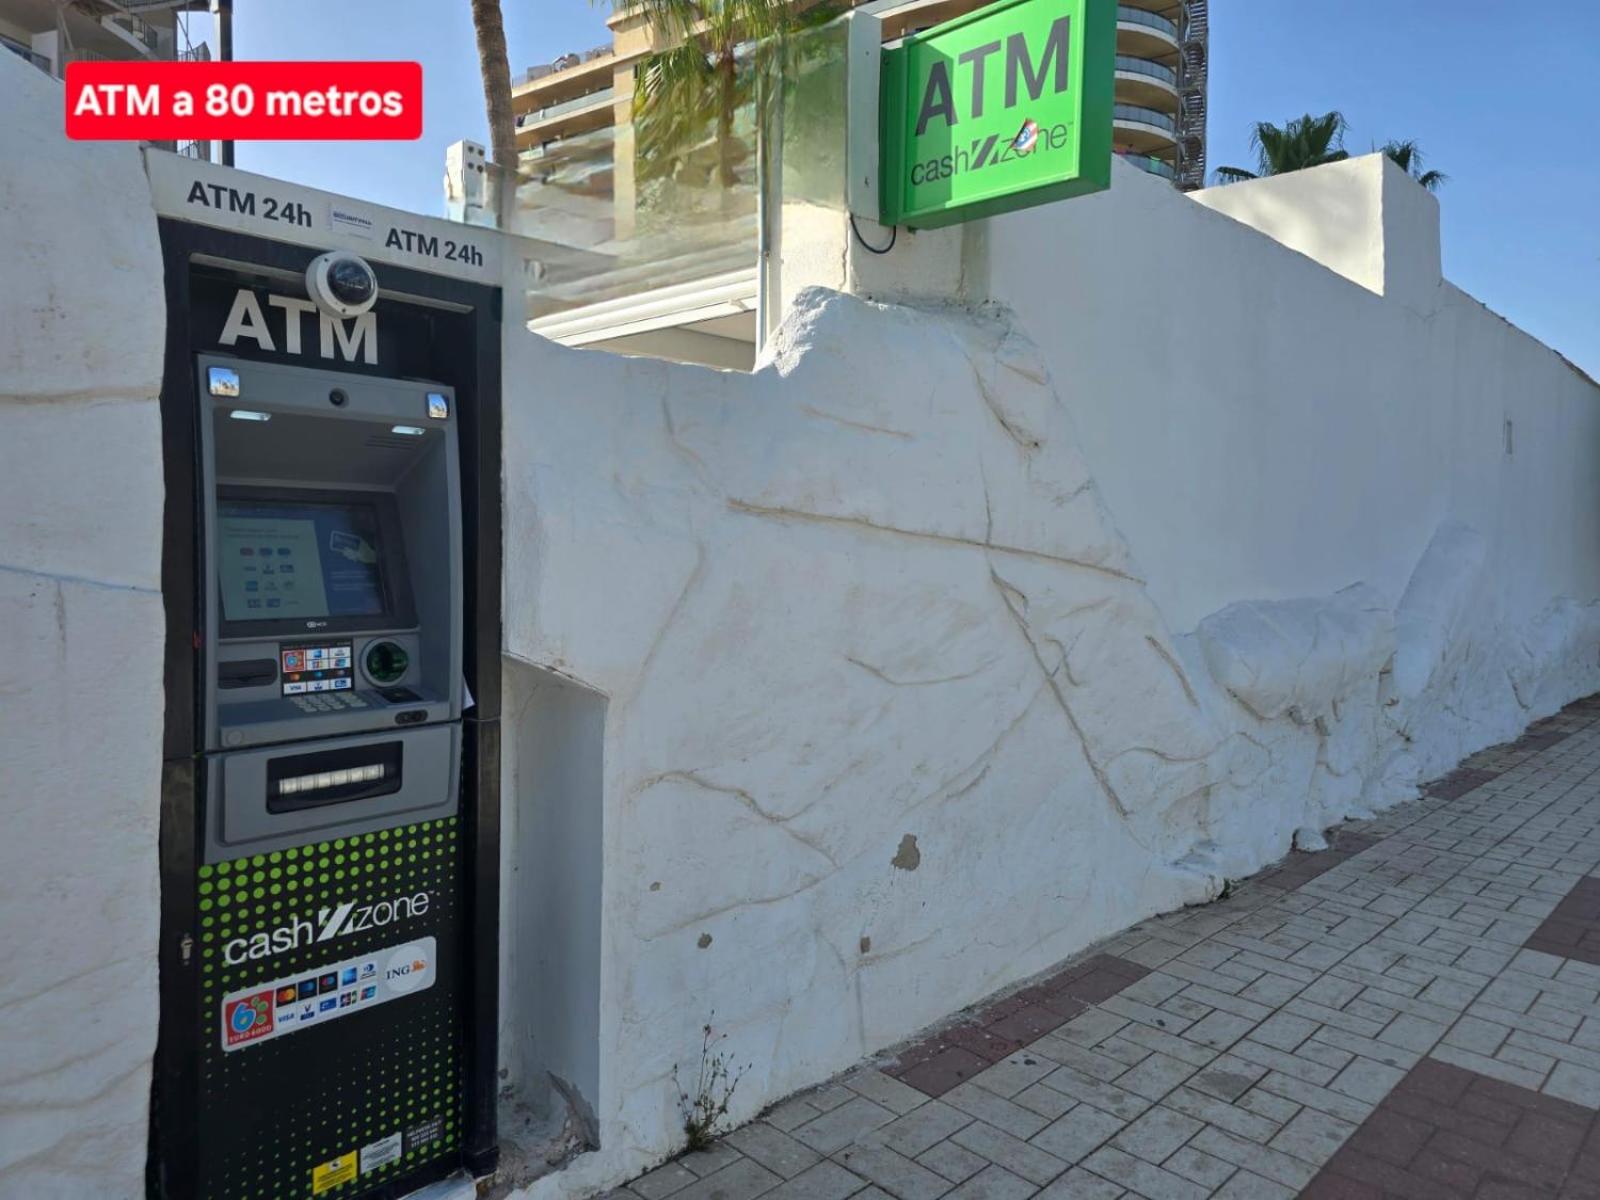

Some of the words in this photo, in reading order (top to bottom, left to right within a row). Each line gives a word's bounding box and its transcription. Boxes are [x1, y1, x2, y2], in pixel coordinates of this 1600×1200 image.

[915, 16, 1071, 137] ATM
[911, 145, 969, 186] cash
[999, 123, 1068, 163] zne
[187, 180, 256, 216] ATM
[262, 198, 312, 228] 24h
[385, 228, 439, 258] ATM
[444, 240, 484, 267] 24h
[218, 288, 379, 365] ATM
[224, 916, 314, 965] cash
[355, 892, 430, 932] zone
[385, 965, 411, 981] ING
